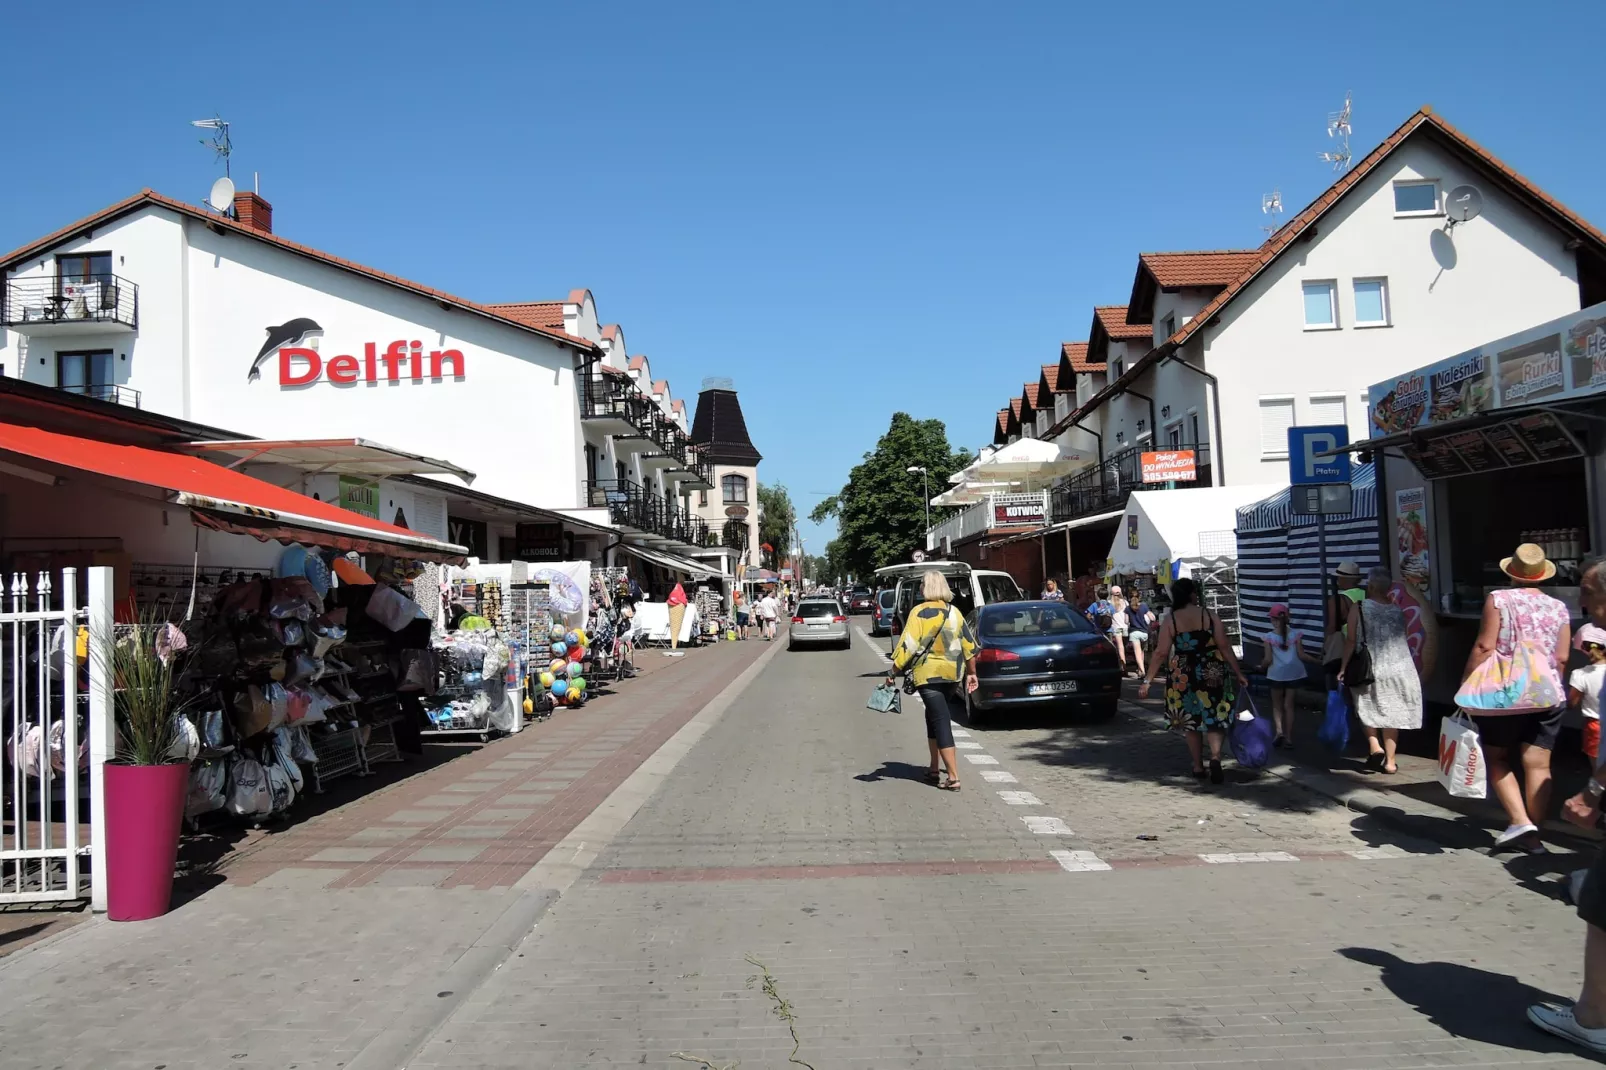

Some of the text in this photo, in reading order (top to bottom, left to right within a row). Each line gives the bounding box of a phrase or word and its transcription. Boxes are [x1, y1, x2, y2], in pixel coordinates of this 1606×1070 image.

[279, 340, 465, 385] Delfin
[1436, 354, 1485, 389] Naleśniki
[1522, 351, 1561, 381] Rurki
[1396, 374, 1425, 396] Gofry
[1143, 463, 1155, 472] DO
[1303, 433, 1336, 476] P
[1006, 505, 1044, 517] KOTWICA
[520, 547, 559, 556] ALKOHOLE
[1051, 681, 1076, 691] 02356
[1464, 747, 1478, 786] MIGROS
